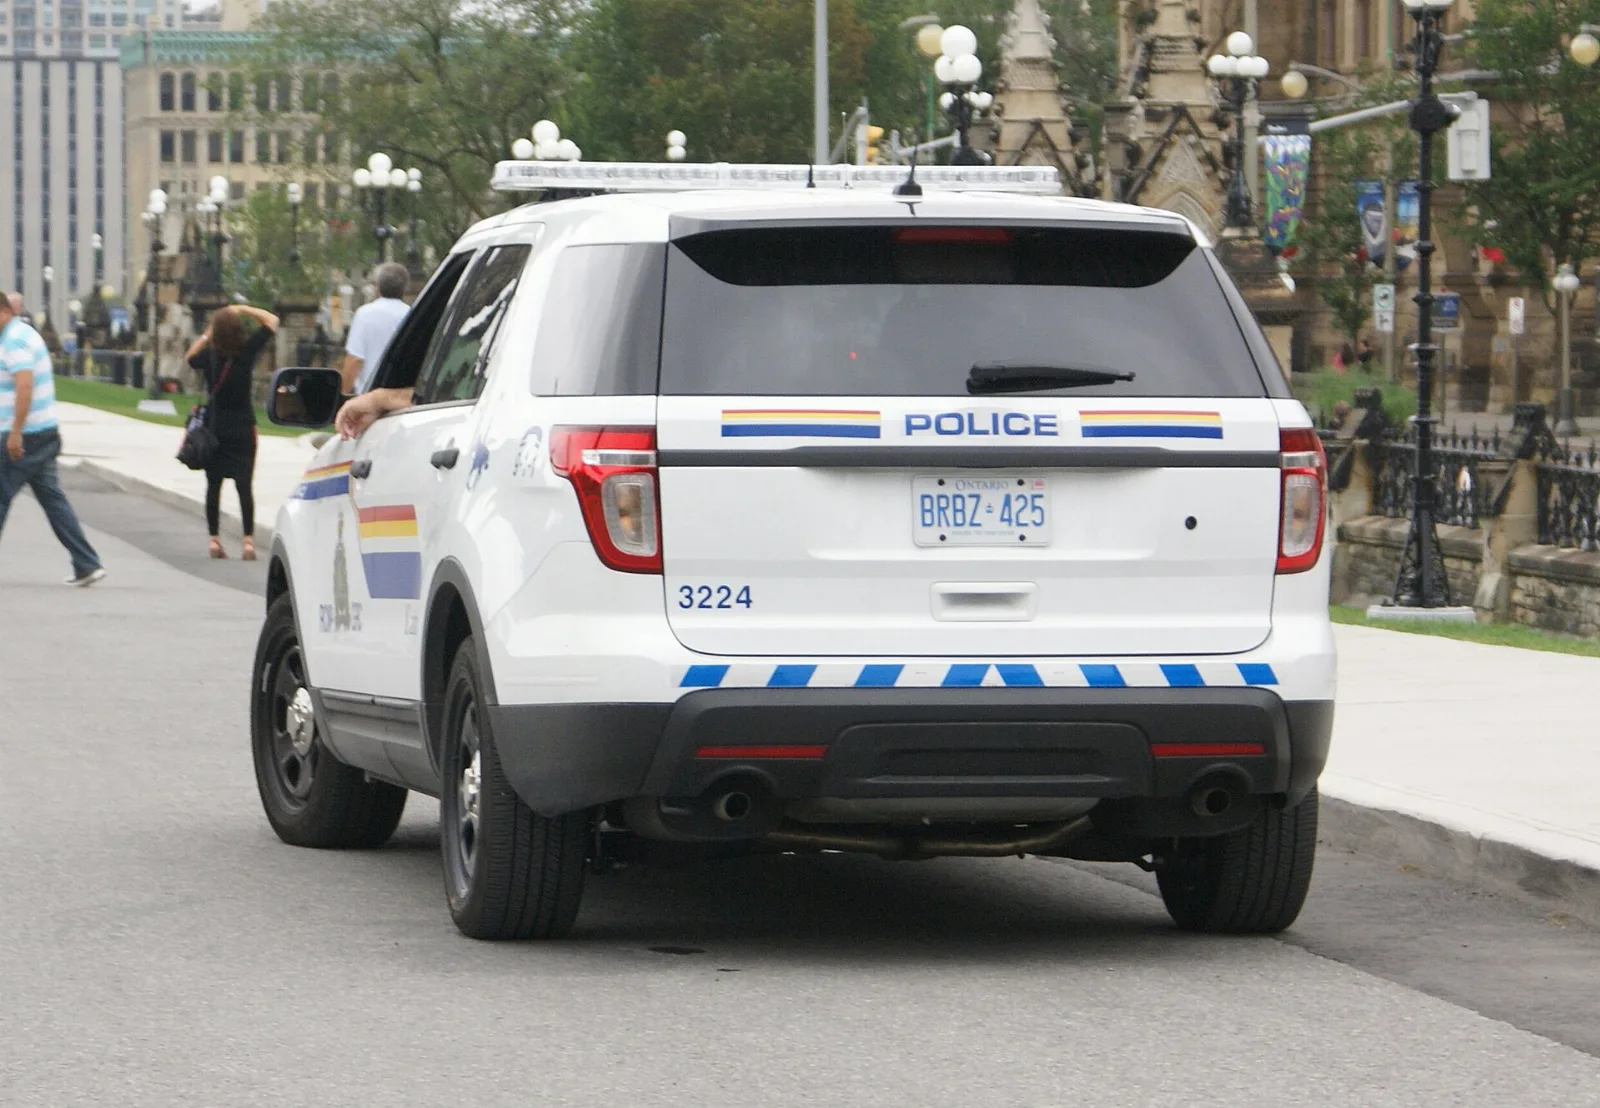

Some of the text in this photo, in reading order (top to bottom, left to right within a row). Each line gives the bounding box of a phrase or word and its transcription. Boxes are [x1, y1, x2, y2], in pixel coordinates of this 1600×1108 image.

[905, 412, 1058, 436] POLICE
[955, 480, 1009, 491] ONTARIO
[920, 493, 1045, 527] BRBZ 425
[678, 585, 753, 609] 3224
